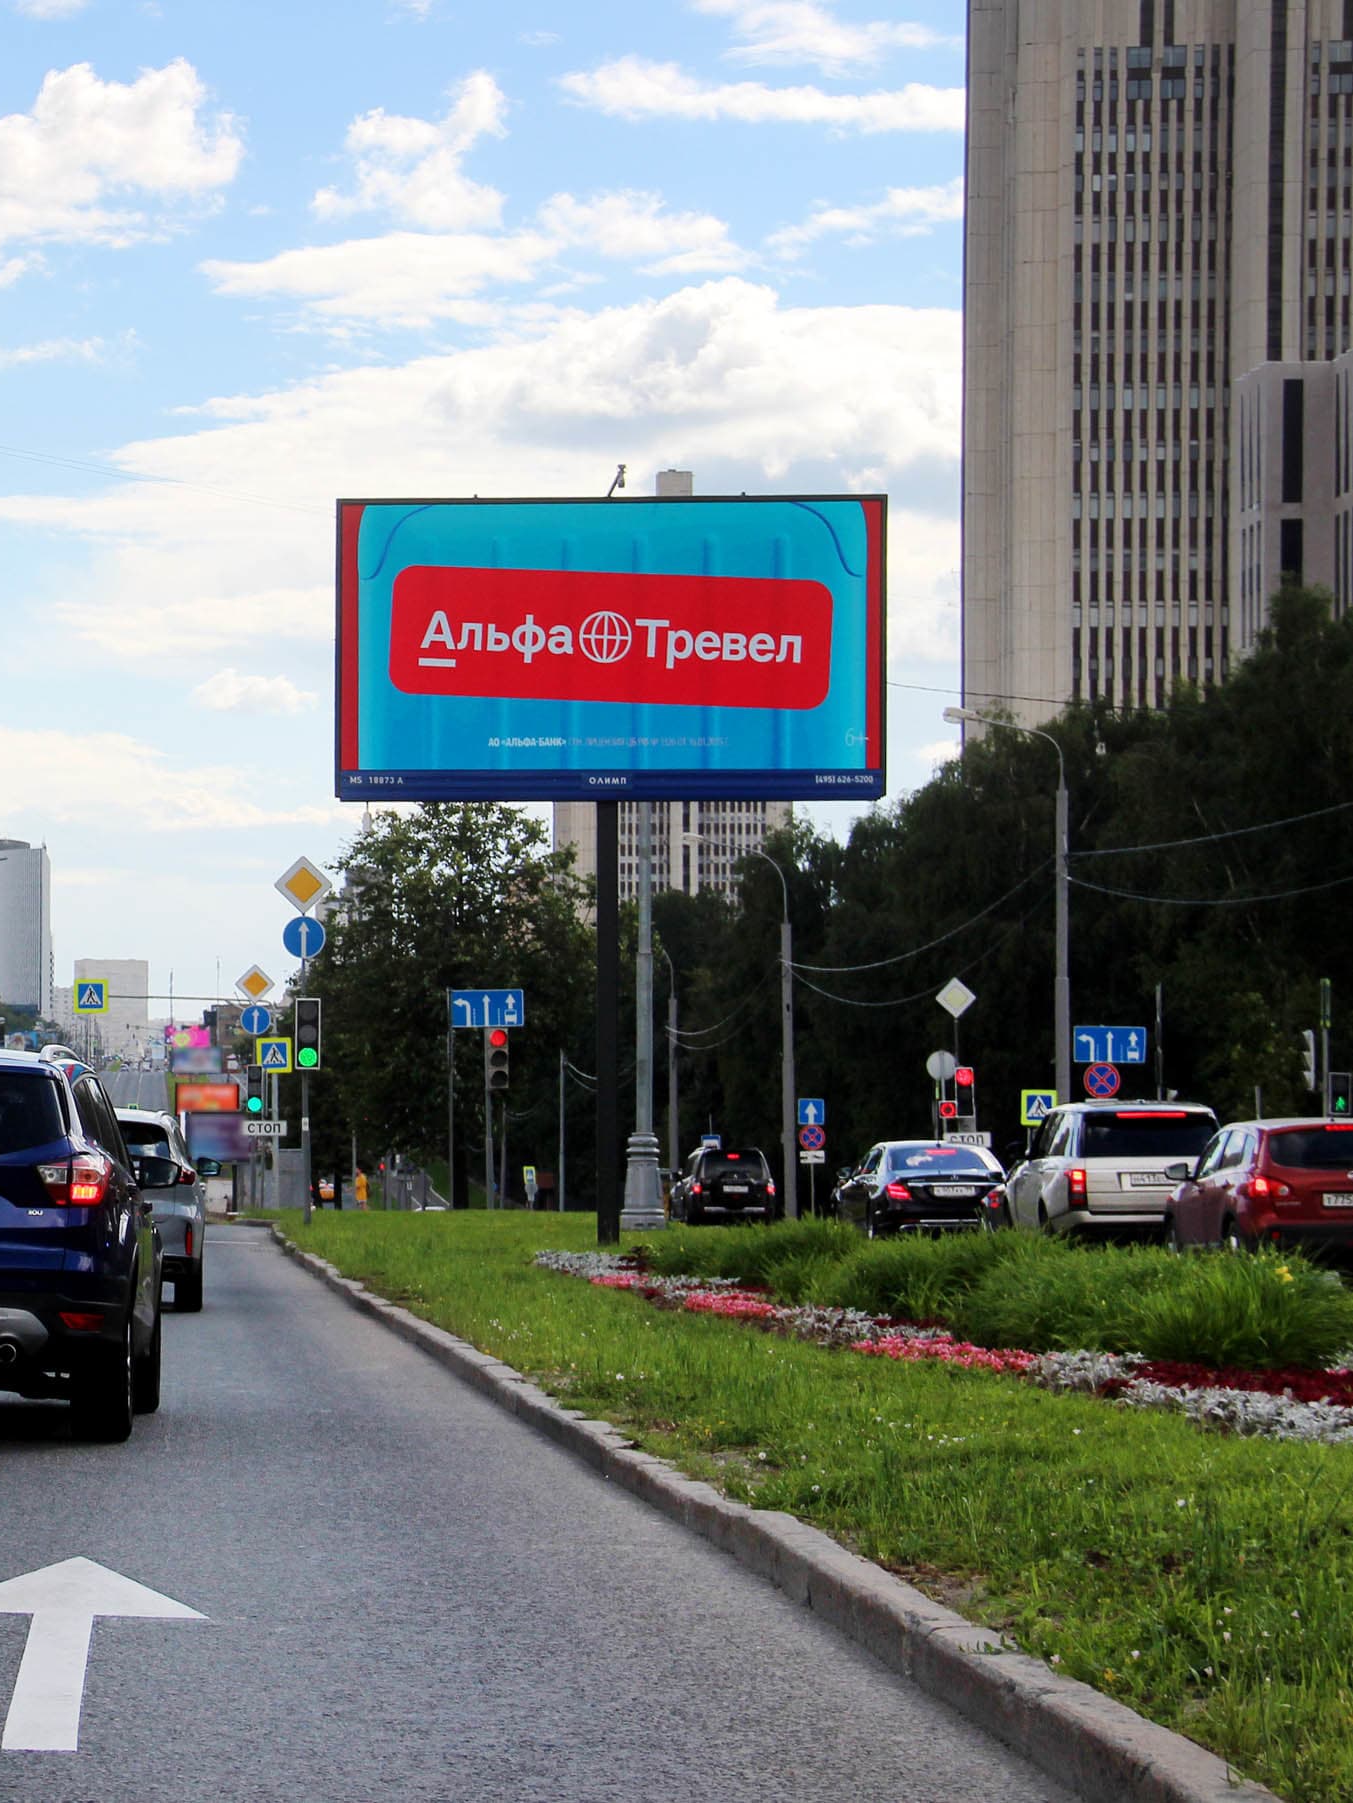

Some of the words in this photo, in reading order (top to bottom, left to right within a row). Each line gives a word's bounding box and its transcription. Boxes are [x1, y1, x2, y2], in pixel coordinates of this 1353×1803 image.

[418, 610, 574, 666] Альфа
[635, 619, 802, 669] Тревел
[588, 776, 627, 784] ОЛИМП
[248, 1123, 281, 1133] СТОП
